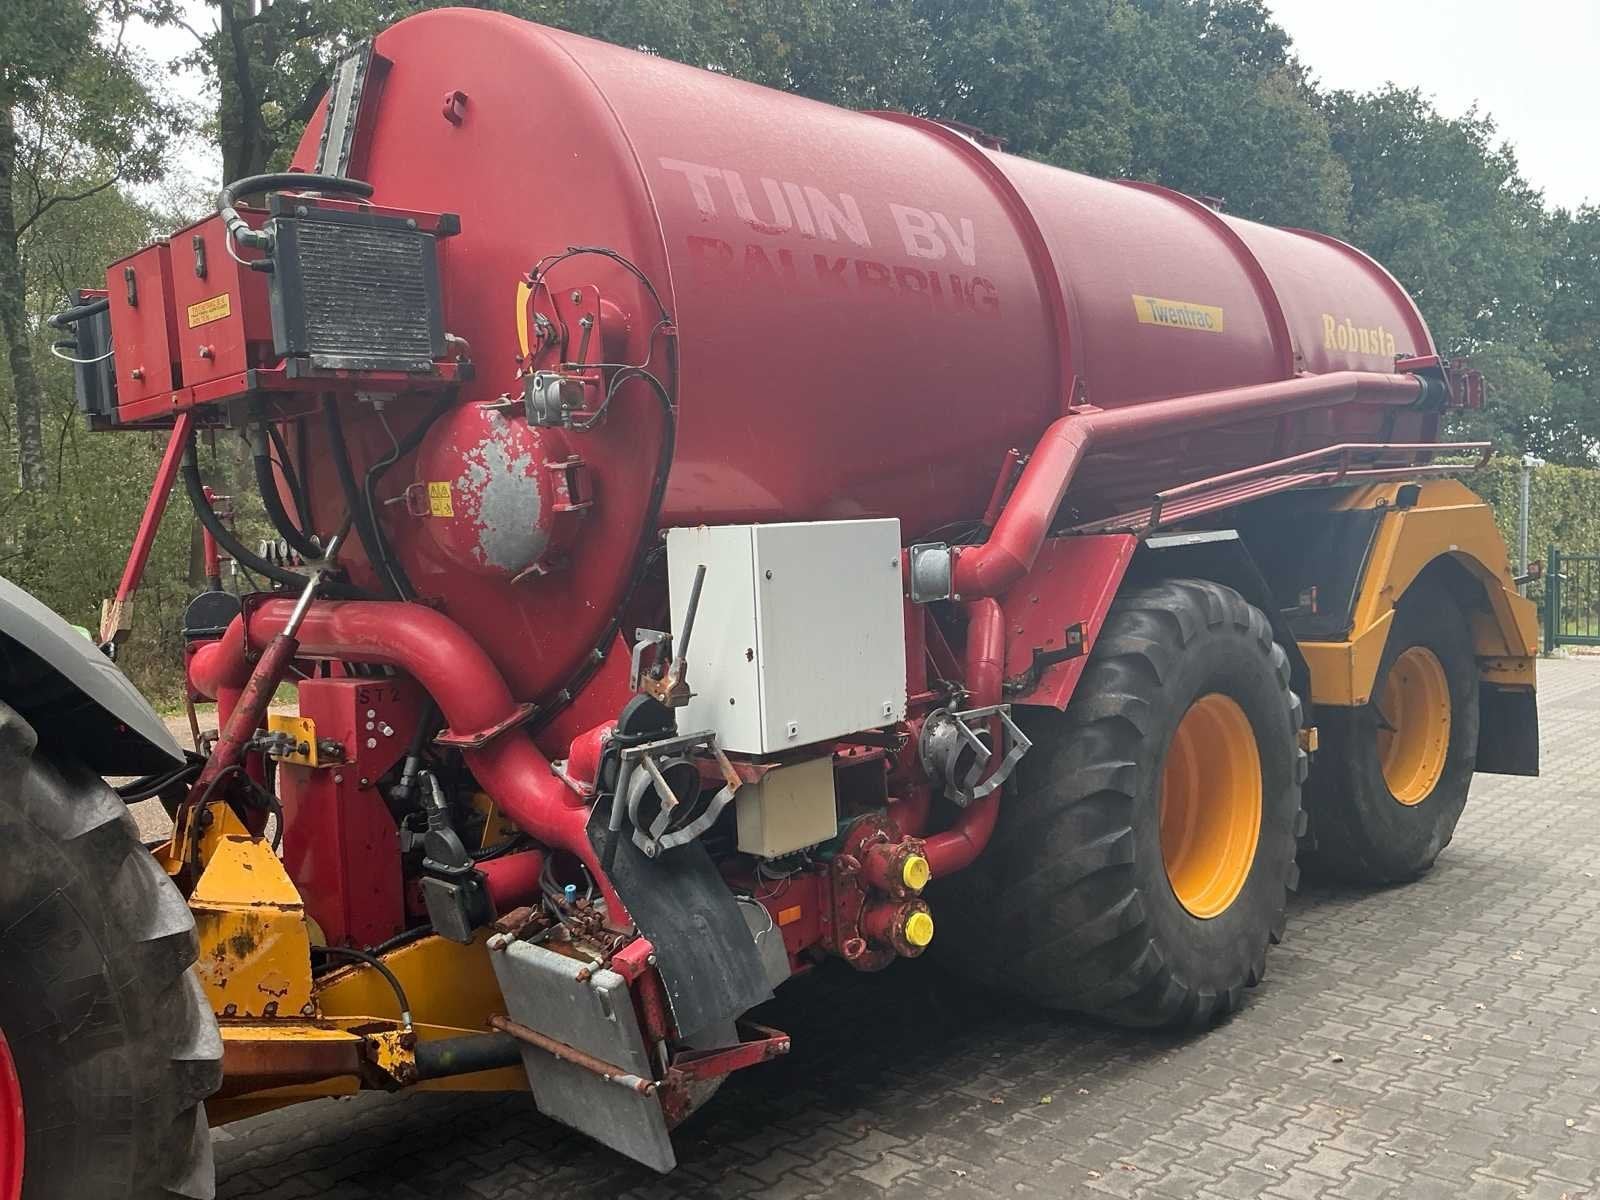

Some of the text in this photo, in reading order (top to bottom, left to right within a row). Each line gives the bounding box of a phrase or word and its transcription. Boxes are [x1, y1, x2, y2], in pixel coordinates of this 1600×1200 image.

[658, 157, 976, 266] TUIN BV
[1145, 299, 1214, 329] Twentrac
[1322, 313, 1395, 357] Robusta
